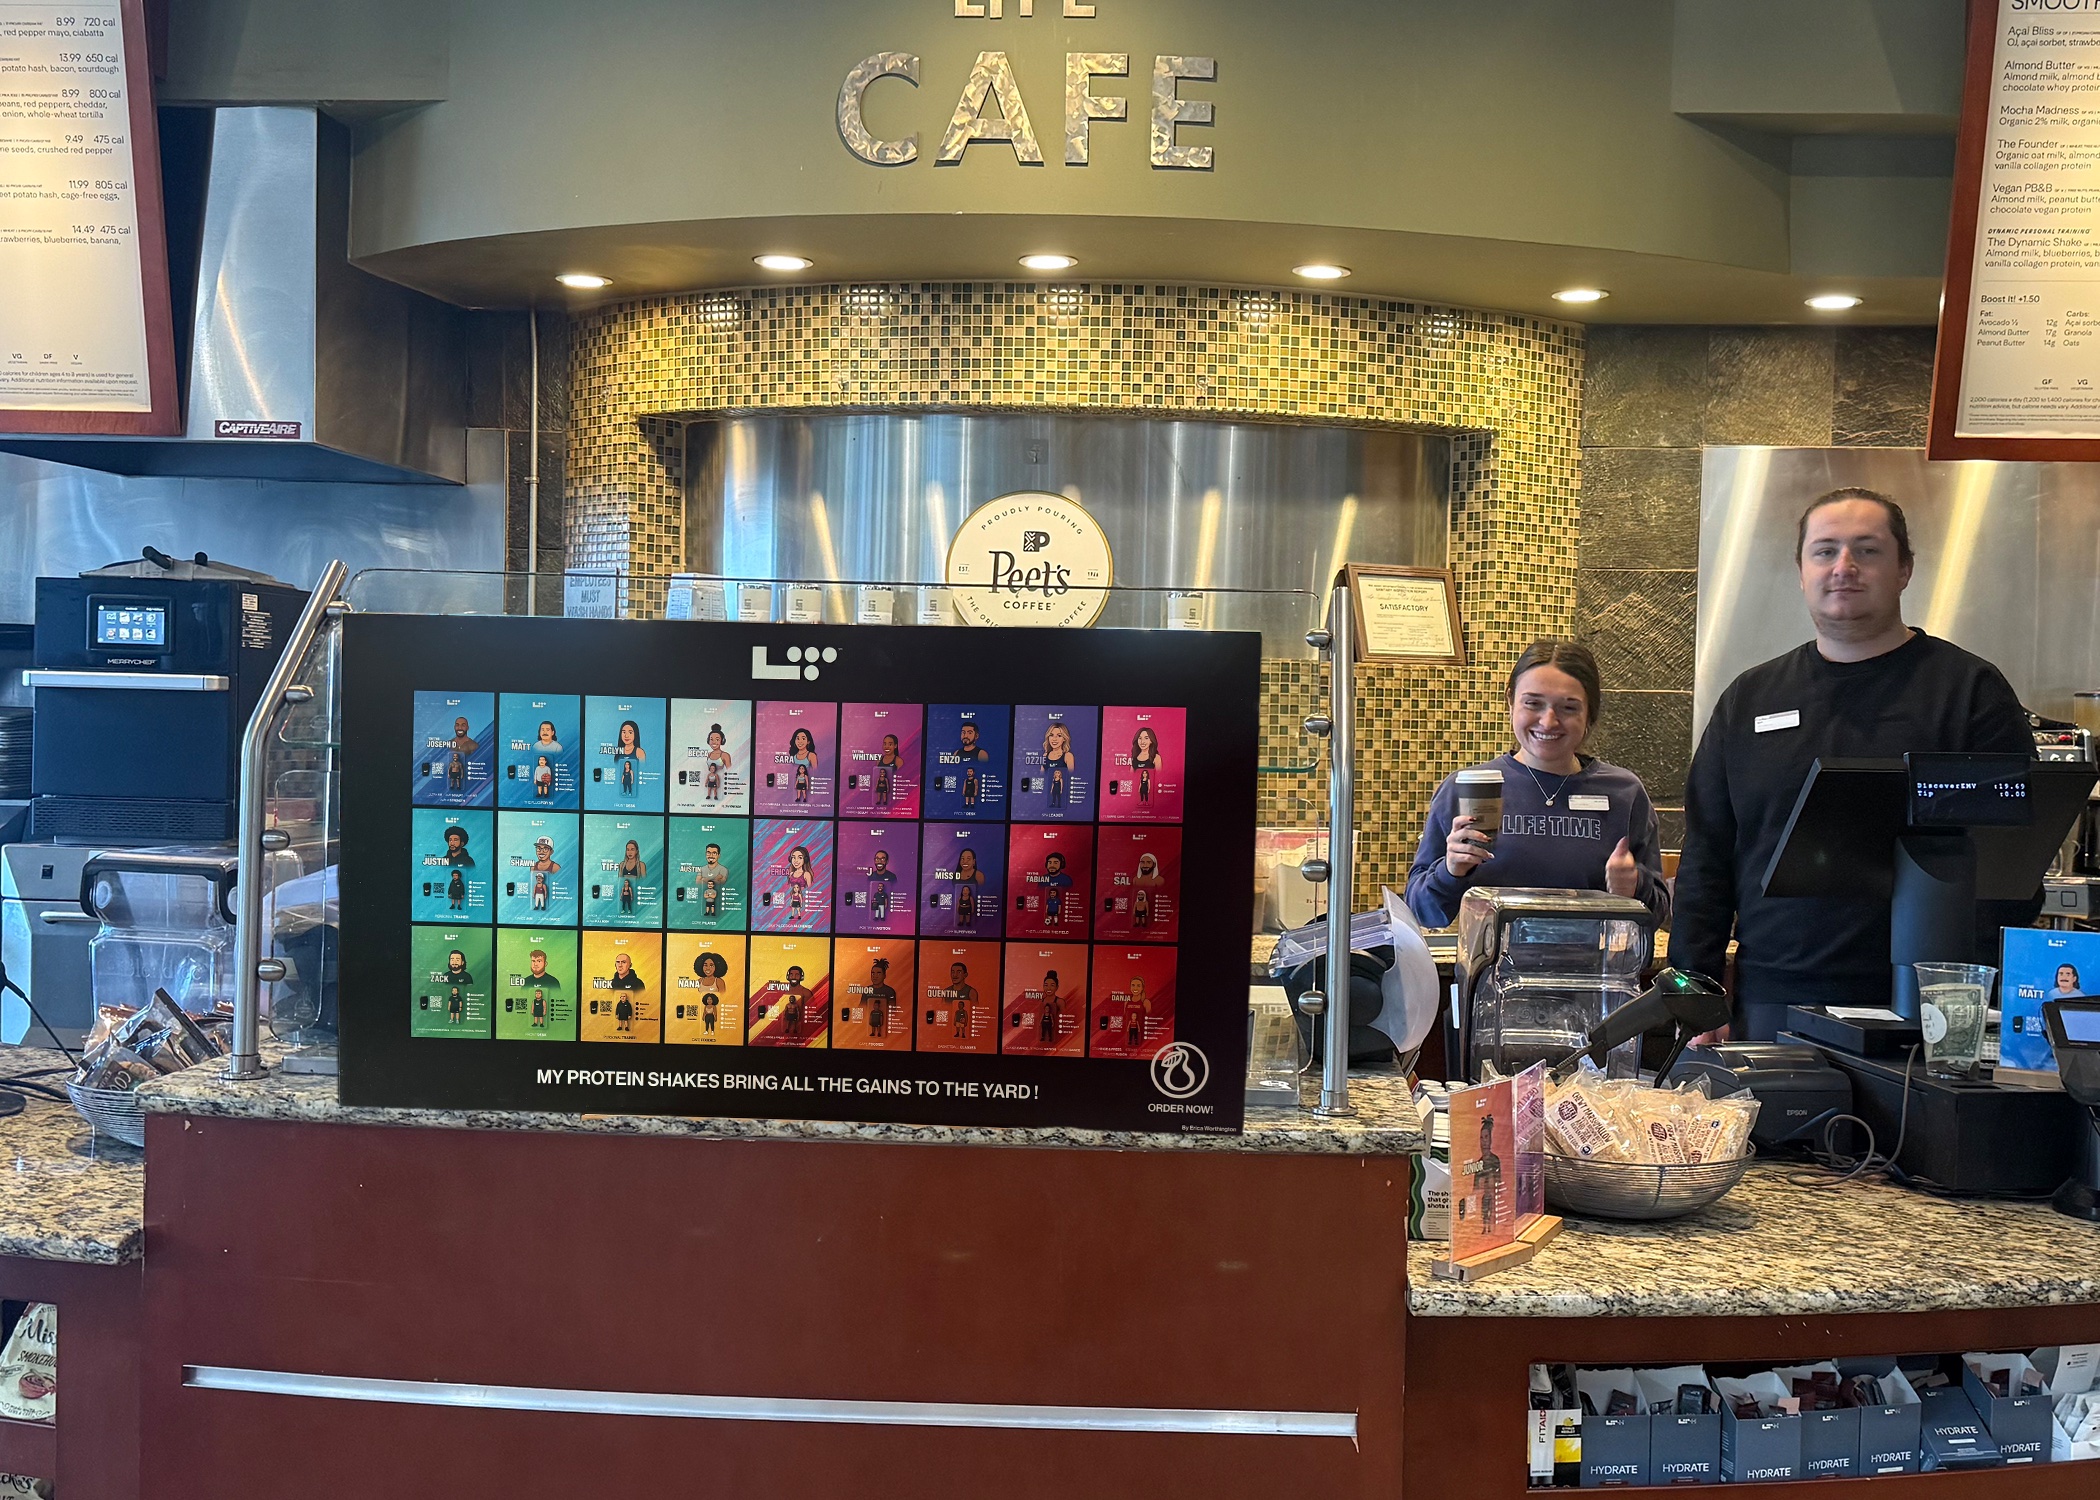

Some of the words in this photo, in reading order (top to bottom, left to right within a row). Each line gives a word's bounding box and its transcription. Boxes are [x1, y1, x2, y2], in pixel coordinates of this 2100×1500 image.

[56, 18, 75, 26] 8.99
[84, 18, 100, 26] 720
[103, 18, 116, 26] cal
[73, 29, 104, 37] ciabatta
[2032, 26, 2054, 35] Bliss
[2039, 39, 2067, 47] sorbet,
[59, 54, 81, 62] 13.99
[86, 54, 103, 62] 650
[106, 54, 118, 63] cal
[50, 65, 76, 73] bacon,
[78, 66, 119, 74] sourdough
[2004, 61, 2043, 70] Almond
[2046, 61, 2075, 70] Butter
[2003, 73, 2037, 81] Almond
[2040, 73, 2060, 81] milk,
[62, 89, 79, 98] 8.99
[89, 90, 107, 98] 800
[109, 90, 121, 98] cal
[2047, 85, 2070, 93] whey
[74, 101, 108, 109] cheddar,
[837, 51, 1217, 171] CAFE
[2001, 106, 2033, 114] Mocha
[2036, 106, 2079, 114] Madness
[1999, 117, 2033, 127] Organic
[2035, 117, 2048, 125] 2%
[2050, 118, 2070, 126] milk,
[65, 135, 84, 143] 9.49
[94, 135, 110, 144] 475
[112, 136, 124, 144] cal
[1998, 139, 2016, 148] The
[2018, 139, 2058, 149] Founder
[38, 146, 69, 154] crushed
[1996, 151, 2029, 160] Organic
[1995, 162, 2021, 170] vanilla
[2024, 163, 2059, 171] collagen
[2061, 162, 2091, 171] protein
[69, 181, 89, 189] 11.99
[95, 181, 113, 189] 805
[115, 181, 128, 189] cal
[1993, 183, 2022, 194] Vegan
[2025, 183, 2052, 192] PB&B
[61, 192, 98, 201] cage-free
[1991, 195, 2025, 203] Almond
[1990, 206, 2032, 214] chocolate
[2061, 206, 2091, 214] protein
[72, 226, 95, 234] 14.49
[100, 226, 116, 234] 475
[118, 226, 131, 234] cal
[1988, 237, 2005, 247] The
[2008, 238, 2050, 248] Dynamic
[2053, 238, 2082, 247] Shake
[1985, 249, 2019, 257] Almond
[2014, 260, 2048, 269] collagen
[1981, 295, 2006, 303] Boost
[2018, 295, 2040, 303] +1.50
[981, 506, 1030, 530] PROUDLY
[1038, 506, 1083, 535] POURING
[988, 550, 1071, 598] Peet's
[581, 590, 600, 603] MUST
[1004, 601, 1051, 611] COFFEE
[567, 606, 589, 618] WASH
[589, 606, 612, 618] HANDS
[968, 596, 980, 613] THE
[1058, 601, 1086, 627] COFFEE
[511, 742, 531, 751] MATT
[599, 746, 625, 755] JACLYN
[775, 755, 794, 764] SARA
[852, 753, 883, 762] WHITNEY
[939, 756, 961, 764] ENZO
[1025, 756, 1047, 765] OZZIE
[1115, 757, 1133, 765] LISA
[1503, 815, 1546, 836] LIFE
[1549, 816, 1601, 840] TIME
[423, 858, 449, 866] JUSTIN
[510, 859, 535, 867] SHAWN
[601, 863, 619, 871] TIFF
[770, 868, 790, 876] ERICA
[935, 872, 954, 880] MISS
[956, 872, 961, 880] D
[1114, 877, 1131, 886] SAL
[430, 975, 449, 984] ZACK
[510, 978, 525, 986] LEO
[678, 980, 700, 988] NANA
[593, 980, 613, 989] NICK
[767, 983, 790, 991] JE'VON
[847, 987, 874, 995] JUNIOR
[927, 990, 958, 998] QUENTIN
[2019, 988, 2044, 999] MATT
[1025, 992, 1044, 1000] MARY
[537, 1069, 564, 1085] MY
[567, 1070, 644, 1086] PROTEIN
[648, 1072, 720, 1089] SHAKES
[723, 1074, 778, 1090] BRING
[782, 1077, 814, 1091] ALL
[818, 1077, 853, 1093] THE
[856, 1078, 911, 1095] GAINS
[915, 1081, 940, 1095] TO
[943, 1082, 979, 1097] THE
[1148, 1104, 1183, 1113] ORDER
[1186, 1105, 1213, 1114] NOW!
[1462, 1161, 1483, 1176] JUNIOR
[1935, 1426, 1979, 1436] HYDRATE
[2001, 1443, 2041, 1454] HYDRATE
[1871, 1452, 1911, 1463] HYDRATE
[1663, 1463, 1710, 1473] HYDRATE
[1808, 1458, 1850, 1471] HYDRATE
[1591, 1465, 1638, 1475] HYDRATE
[1747, 1468, 1791, 1479] HYDRATE
